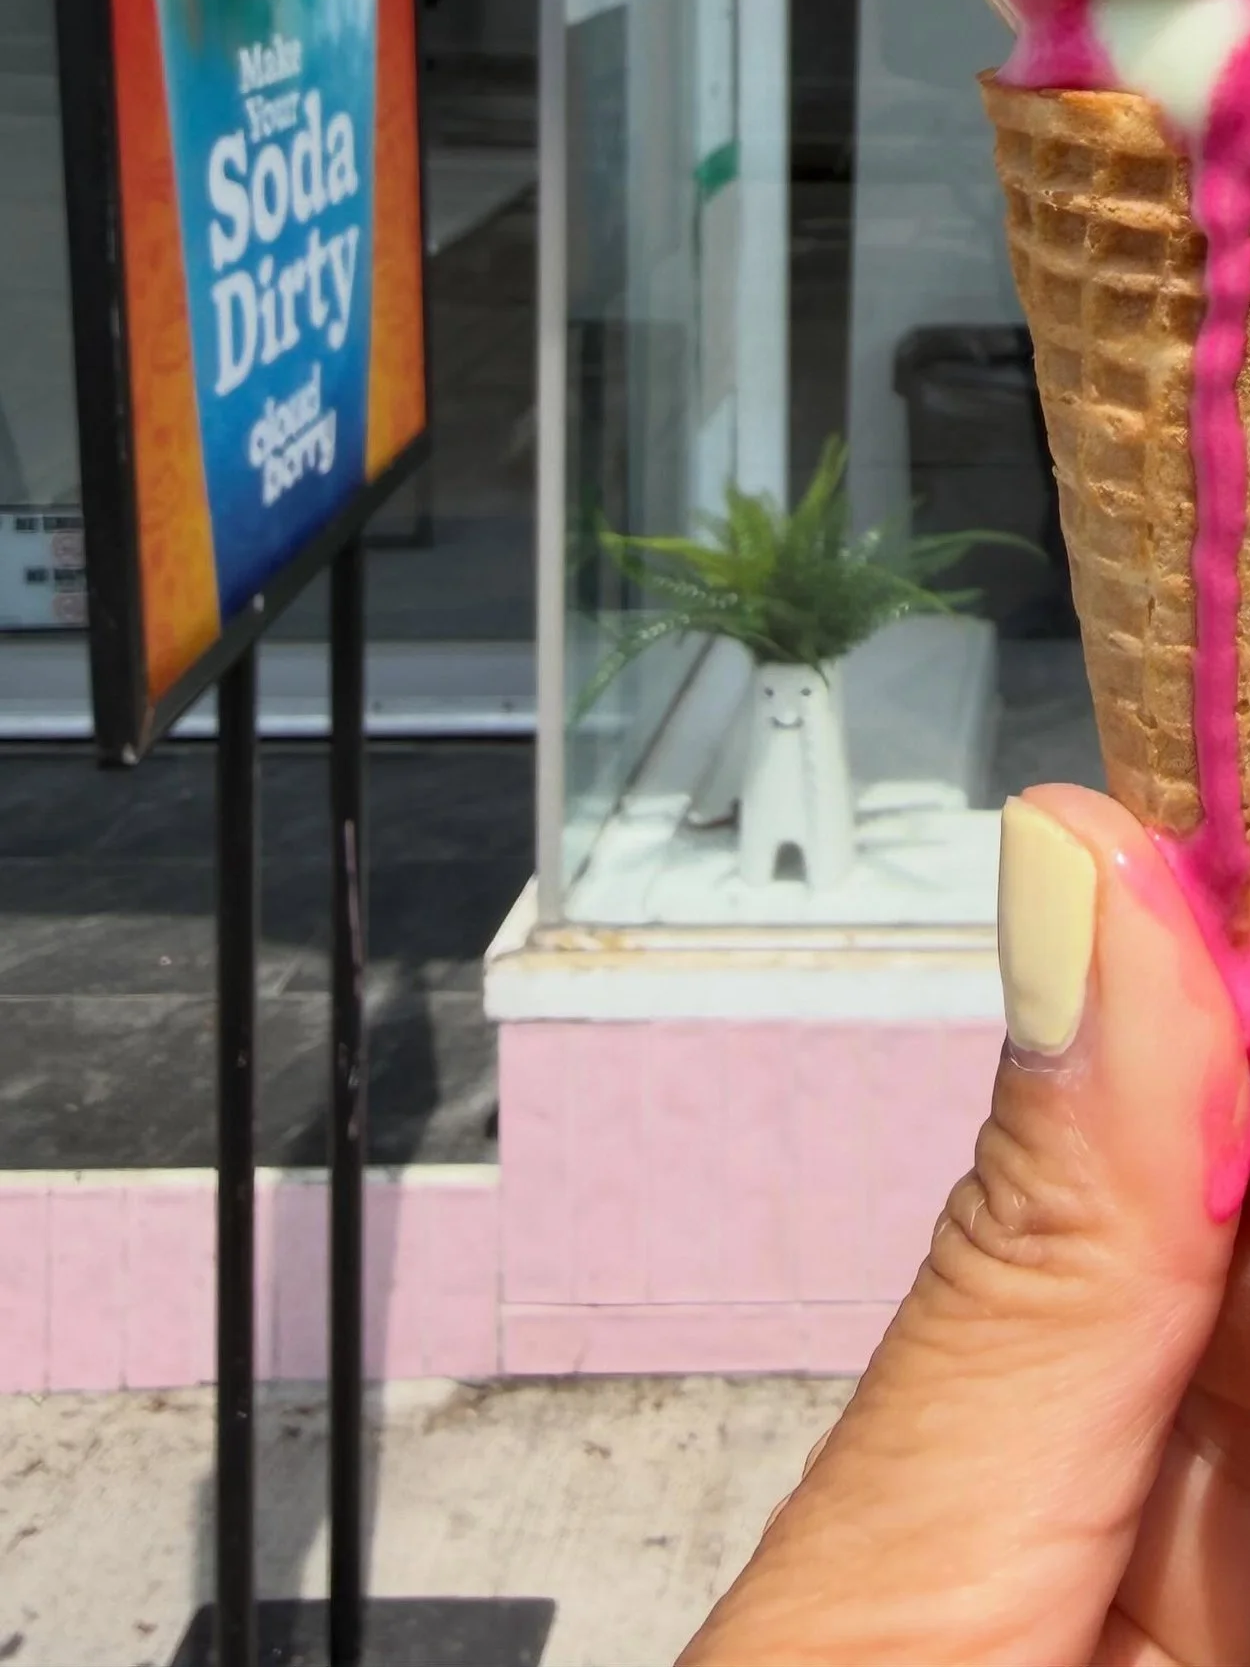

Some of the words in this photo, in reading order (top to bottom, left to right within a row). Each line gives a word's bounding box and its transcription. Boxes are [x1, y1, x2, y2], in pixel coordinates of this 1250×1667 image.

[238, 33, 302, 93] Make
[245, 91, 301, 143] Your
[208, 88, 359, 272] Soda
[211, 223, 360, 398] Dirty
